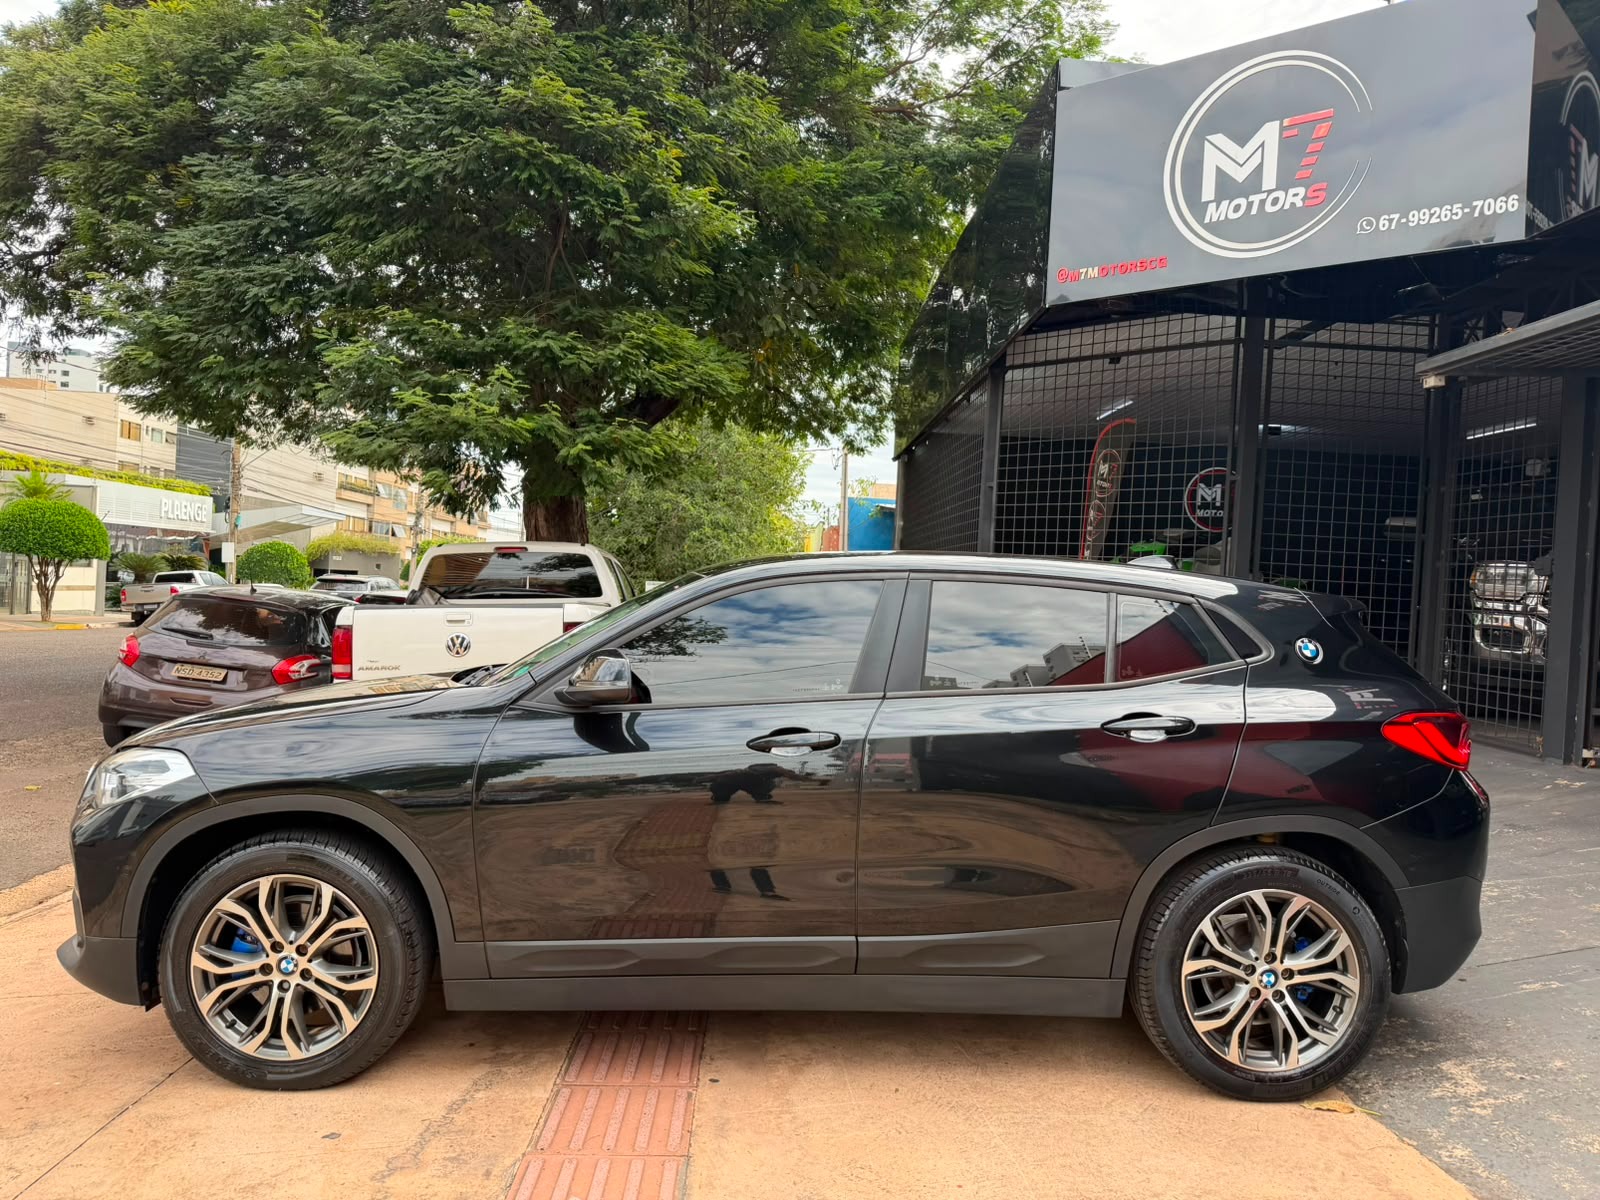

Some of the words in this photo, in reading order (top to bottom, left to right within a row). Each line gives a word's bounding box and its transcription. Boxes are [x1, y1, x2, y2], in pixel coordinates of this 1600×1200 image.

[1201, 107, 1335, 203] M7
[1203, 182, 1329, 224] MOTORS
[1378, 194, 1520, 232] 67-99265-7066
[1057, 256, 1168, 284] @M7MOTORSCG
[161, 498, 208, 522] PLAENGE
[1196, 509, 1224, 517] MOTO
[1316, 879, 1341, 896] OUTSIDE
